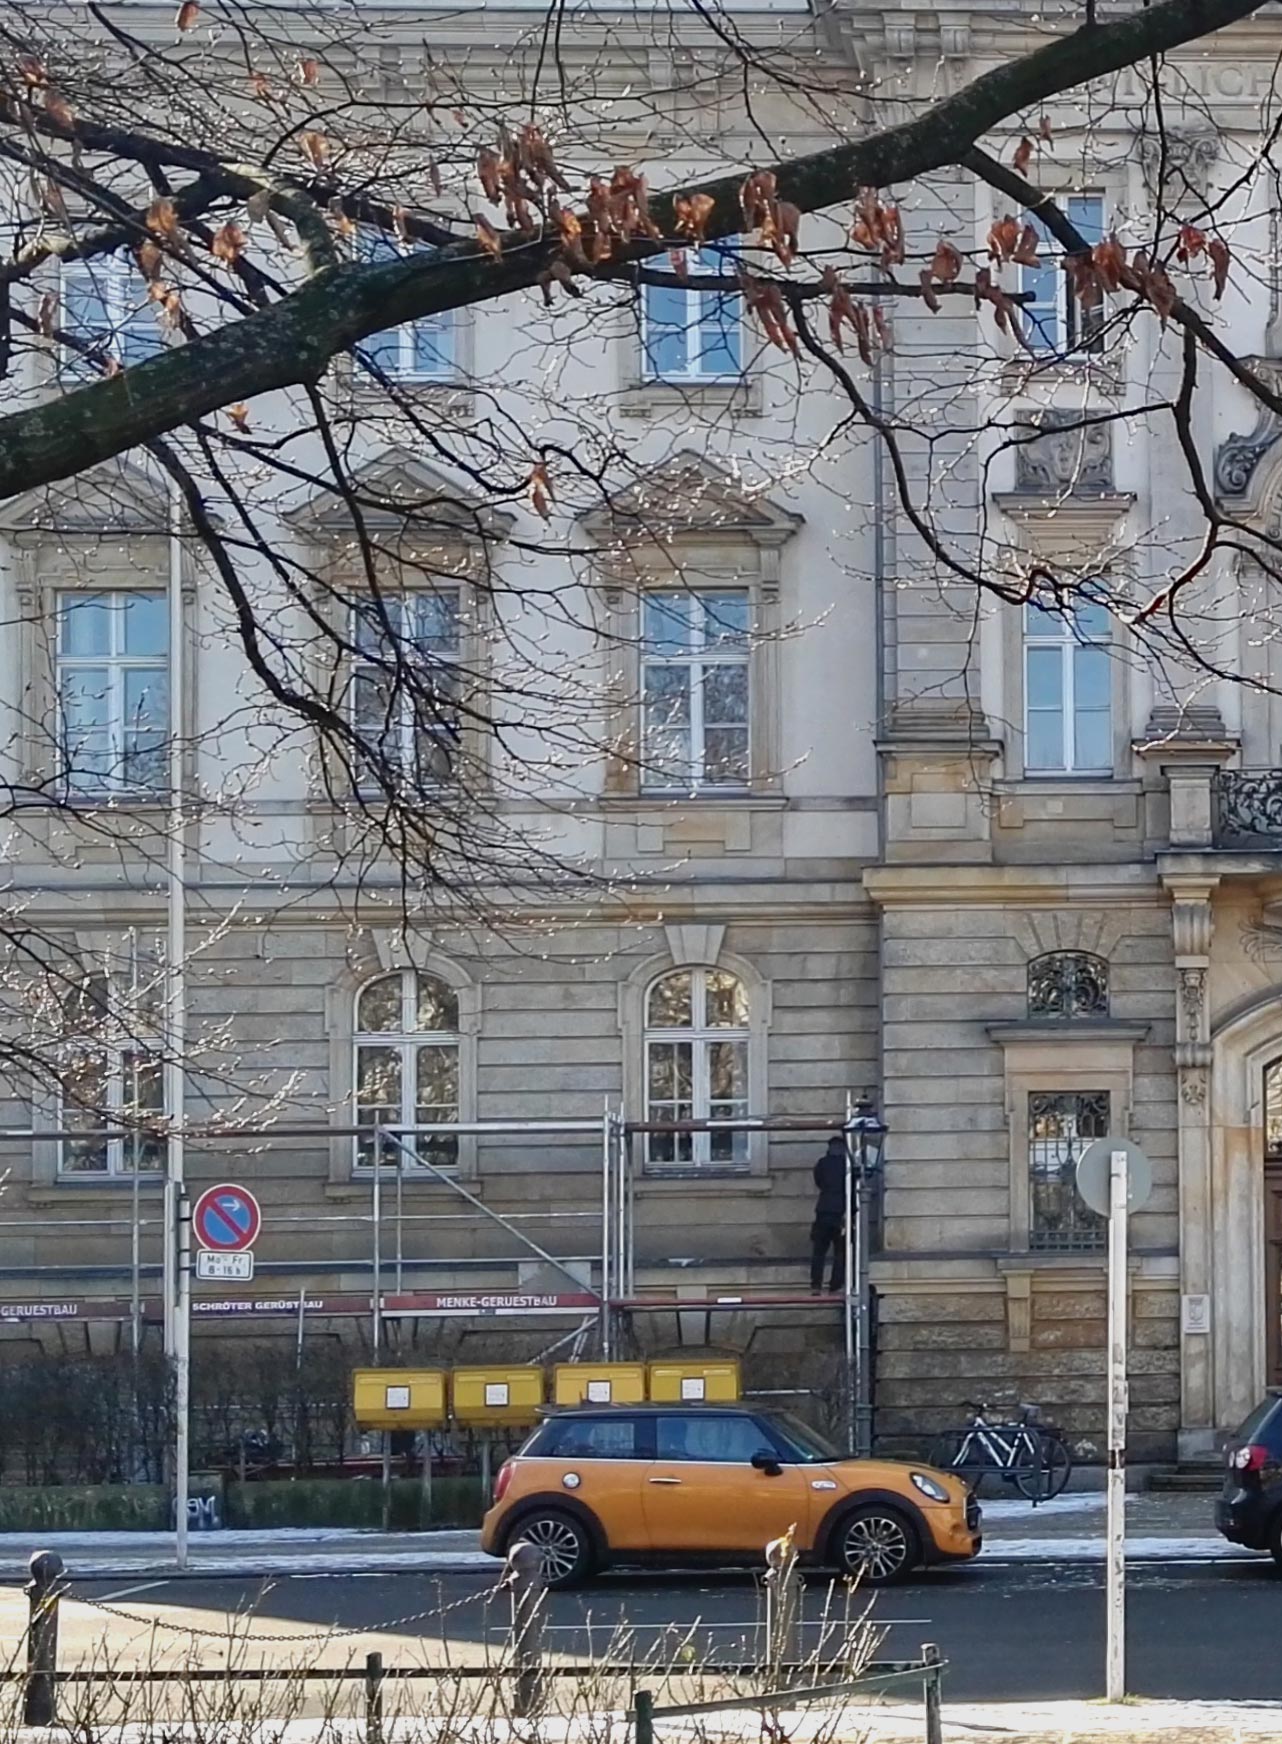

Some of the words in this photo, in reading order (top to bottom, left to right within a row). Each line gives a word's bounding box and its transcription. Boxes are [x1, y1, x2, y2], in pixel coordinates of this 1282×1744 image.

[192, 1300, 253, 1311] SCHRÖTER
[436, 1295, 558, 1308] MENKE-GERUESTBAU
[1, 1303, 78, 1316] GERUESTBAU
